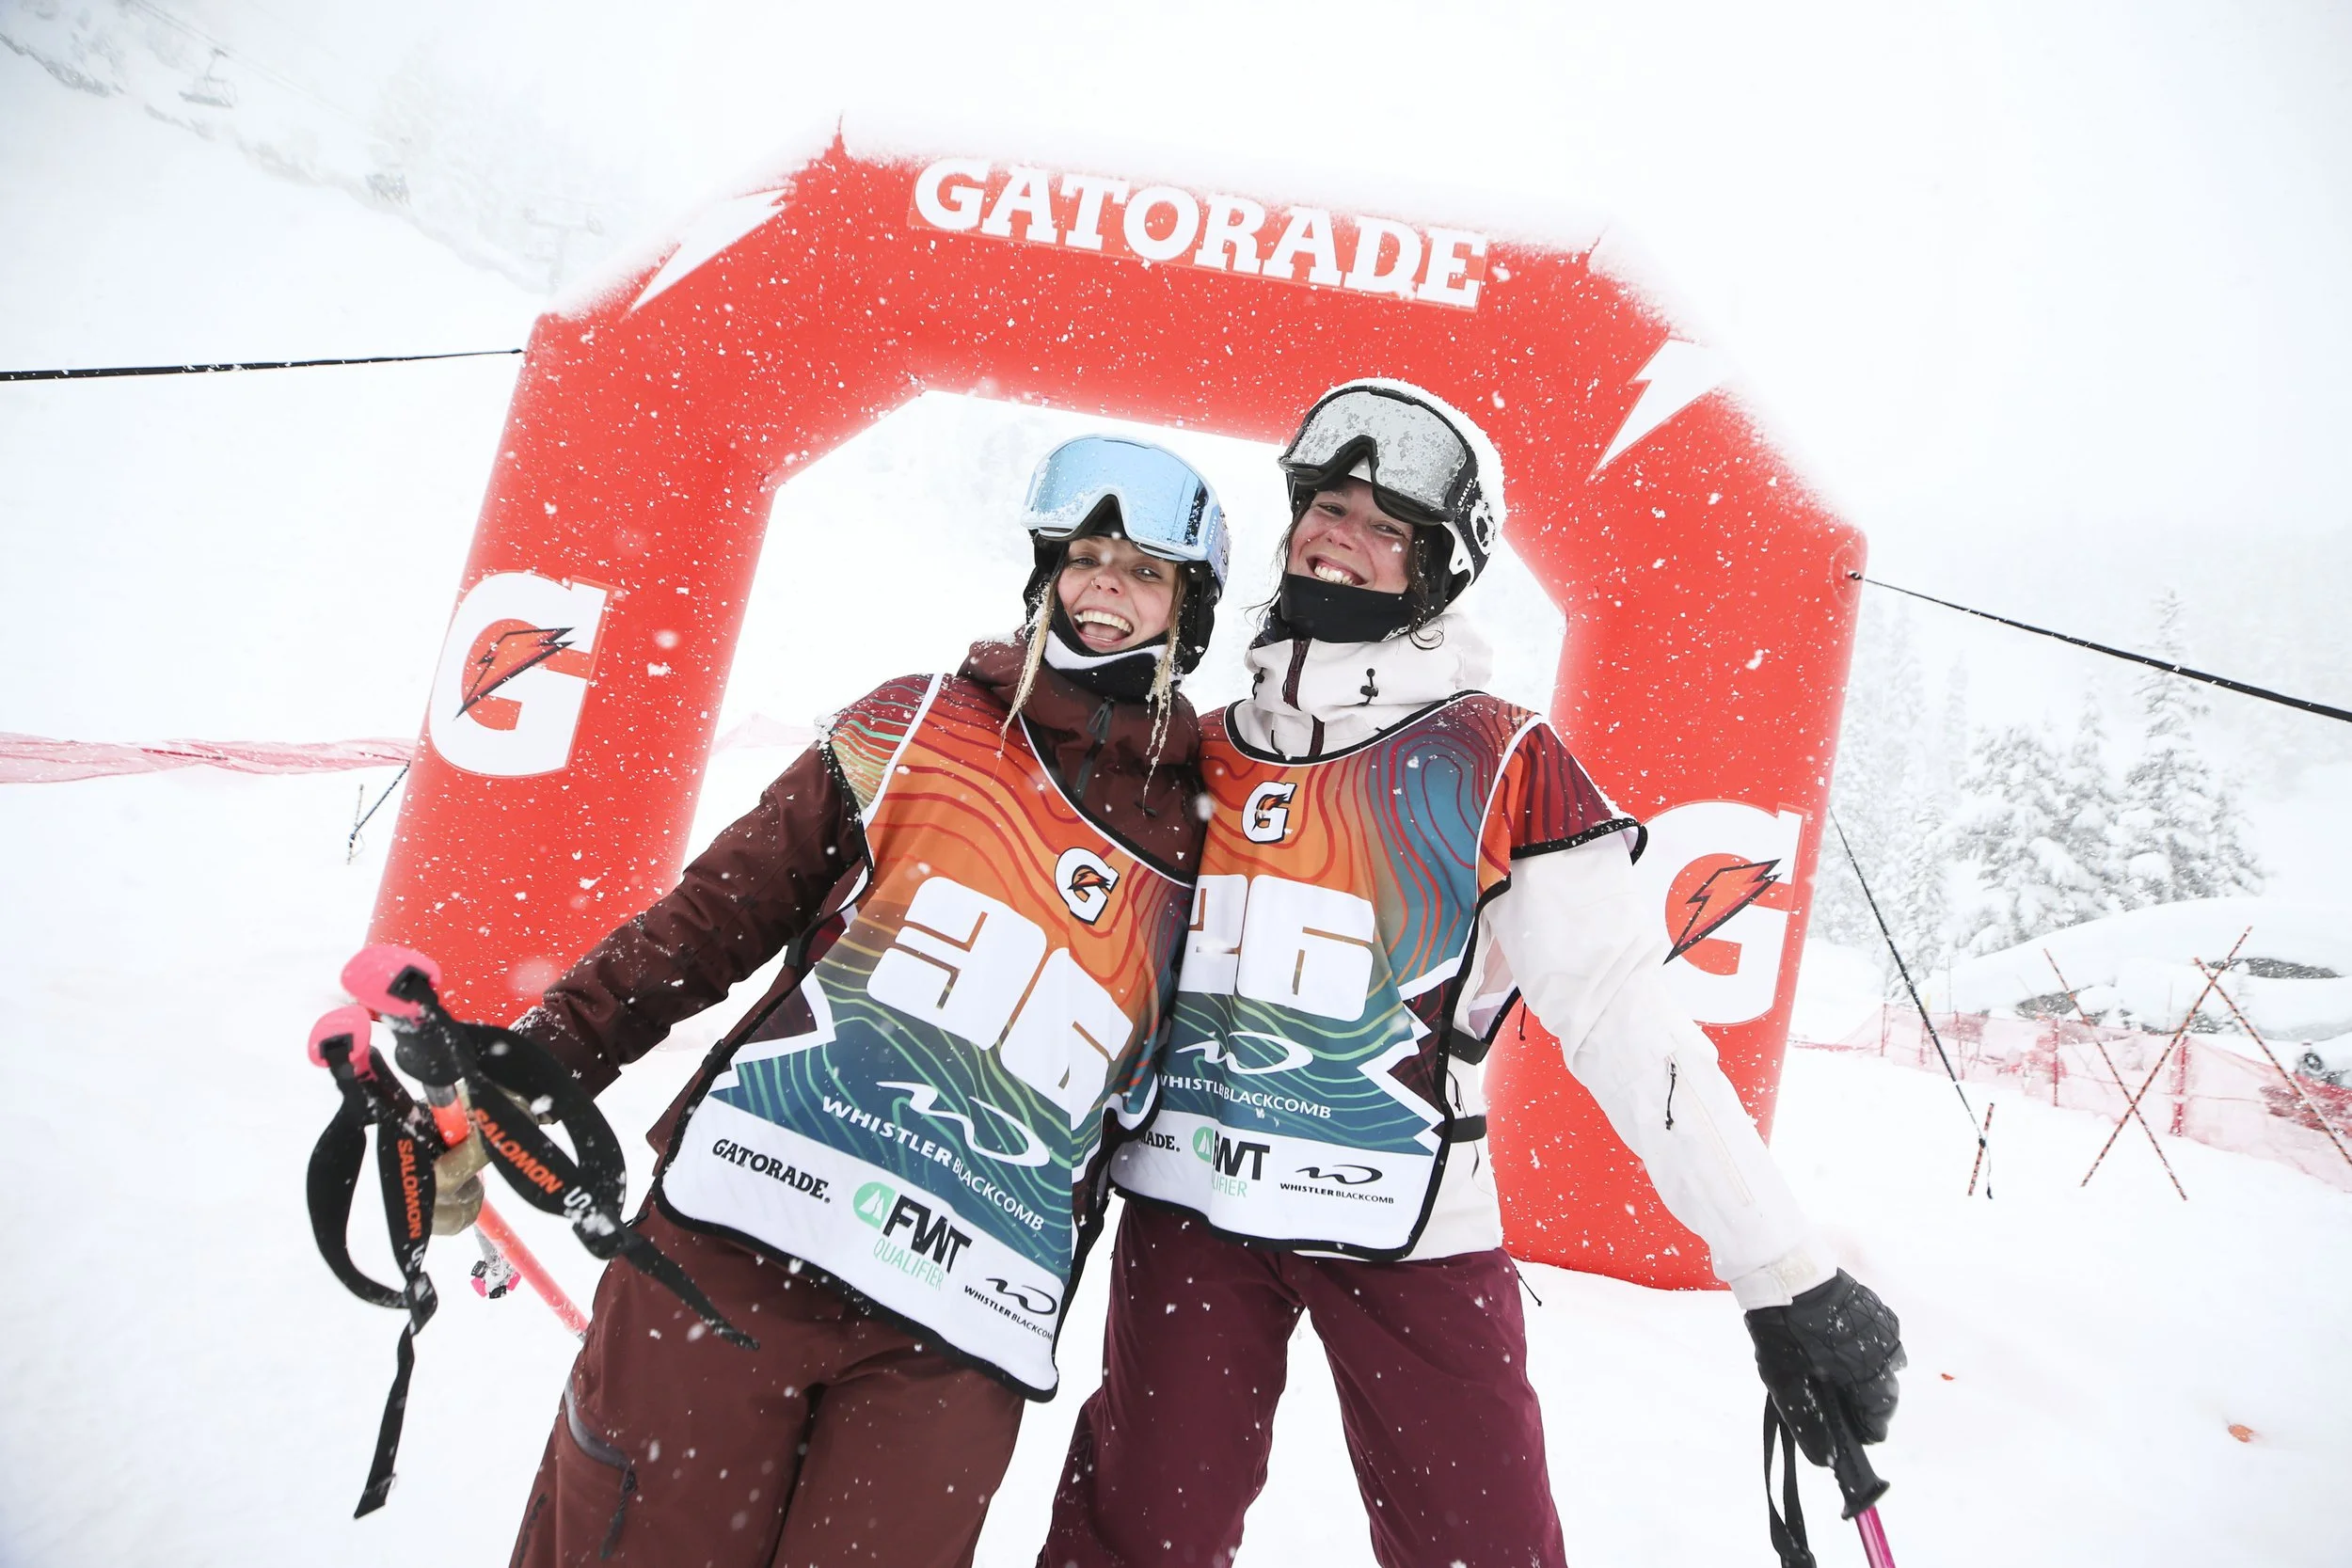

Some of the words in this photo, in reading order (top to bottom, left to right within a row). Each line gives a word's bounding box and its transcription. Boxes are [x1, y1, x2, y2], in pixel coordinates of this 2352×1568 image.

[913, 157, 1487, 308] GATORADE
[1457, 478, 1474, 507] OAKLEY
[866, 876, 1134, 1132] 36
[397, 1138, 422, 1241] SALOMON
[473, 1108, 564, 1195] SALOMON
[873, 1238, 946, 1291] QUALIFIER
[882, 1194, 973, 1275] FWT
